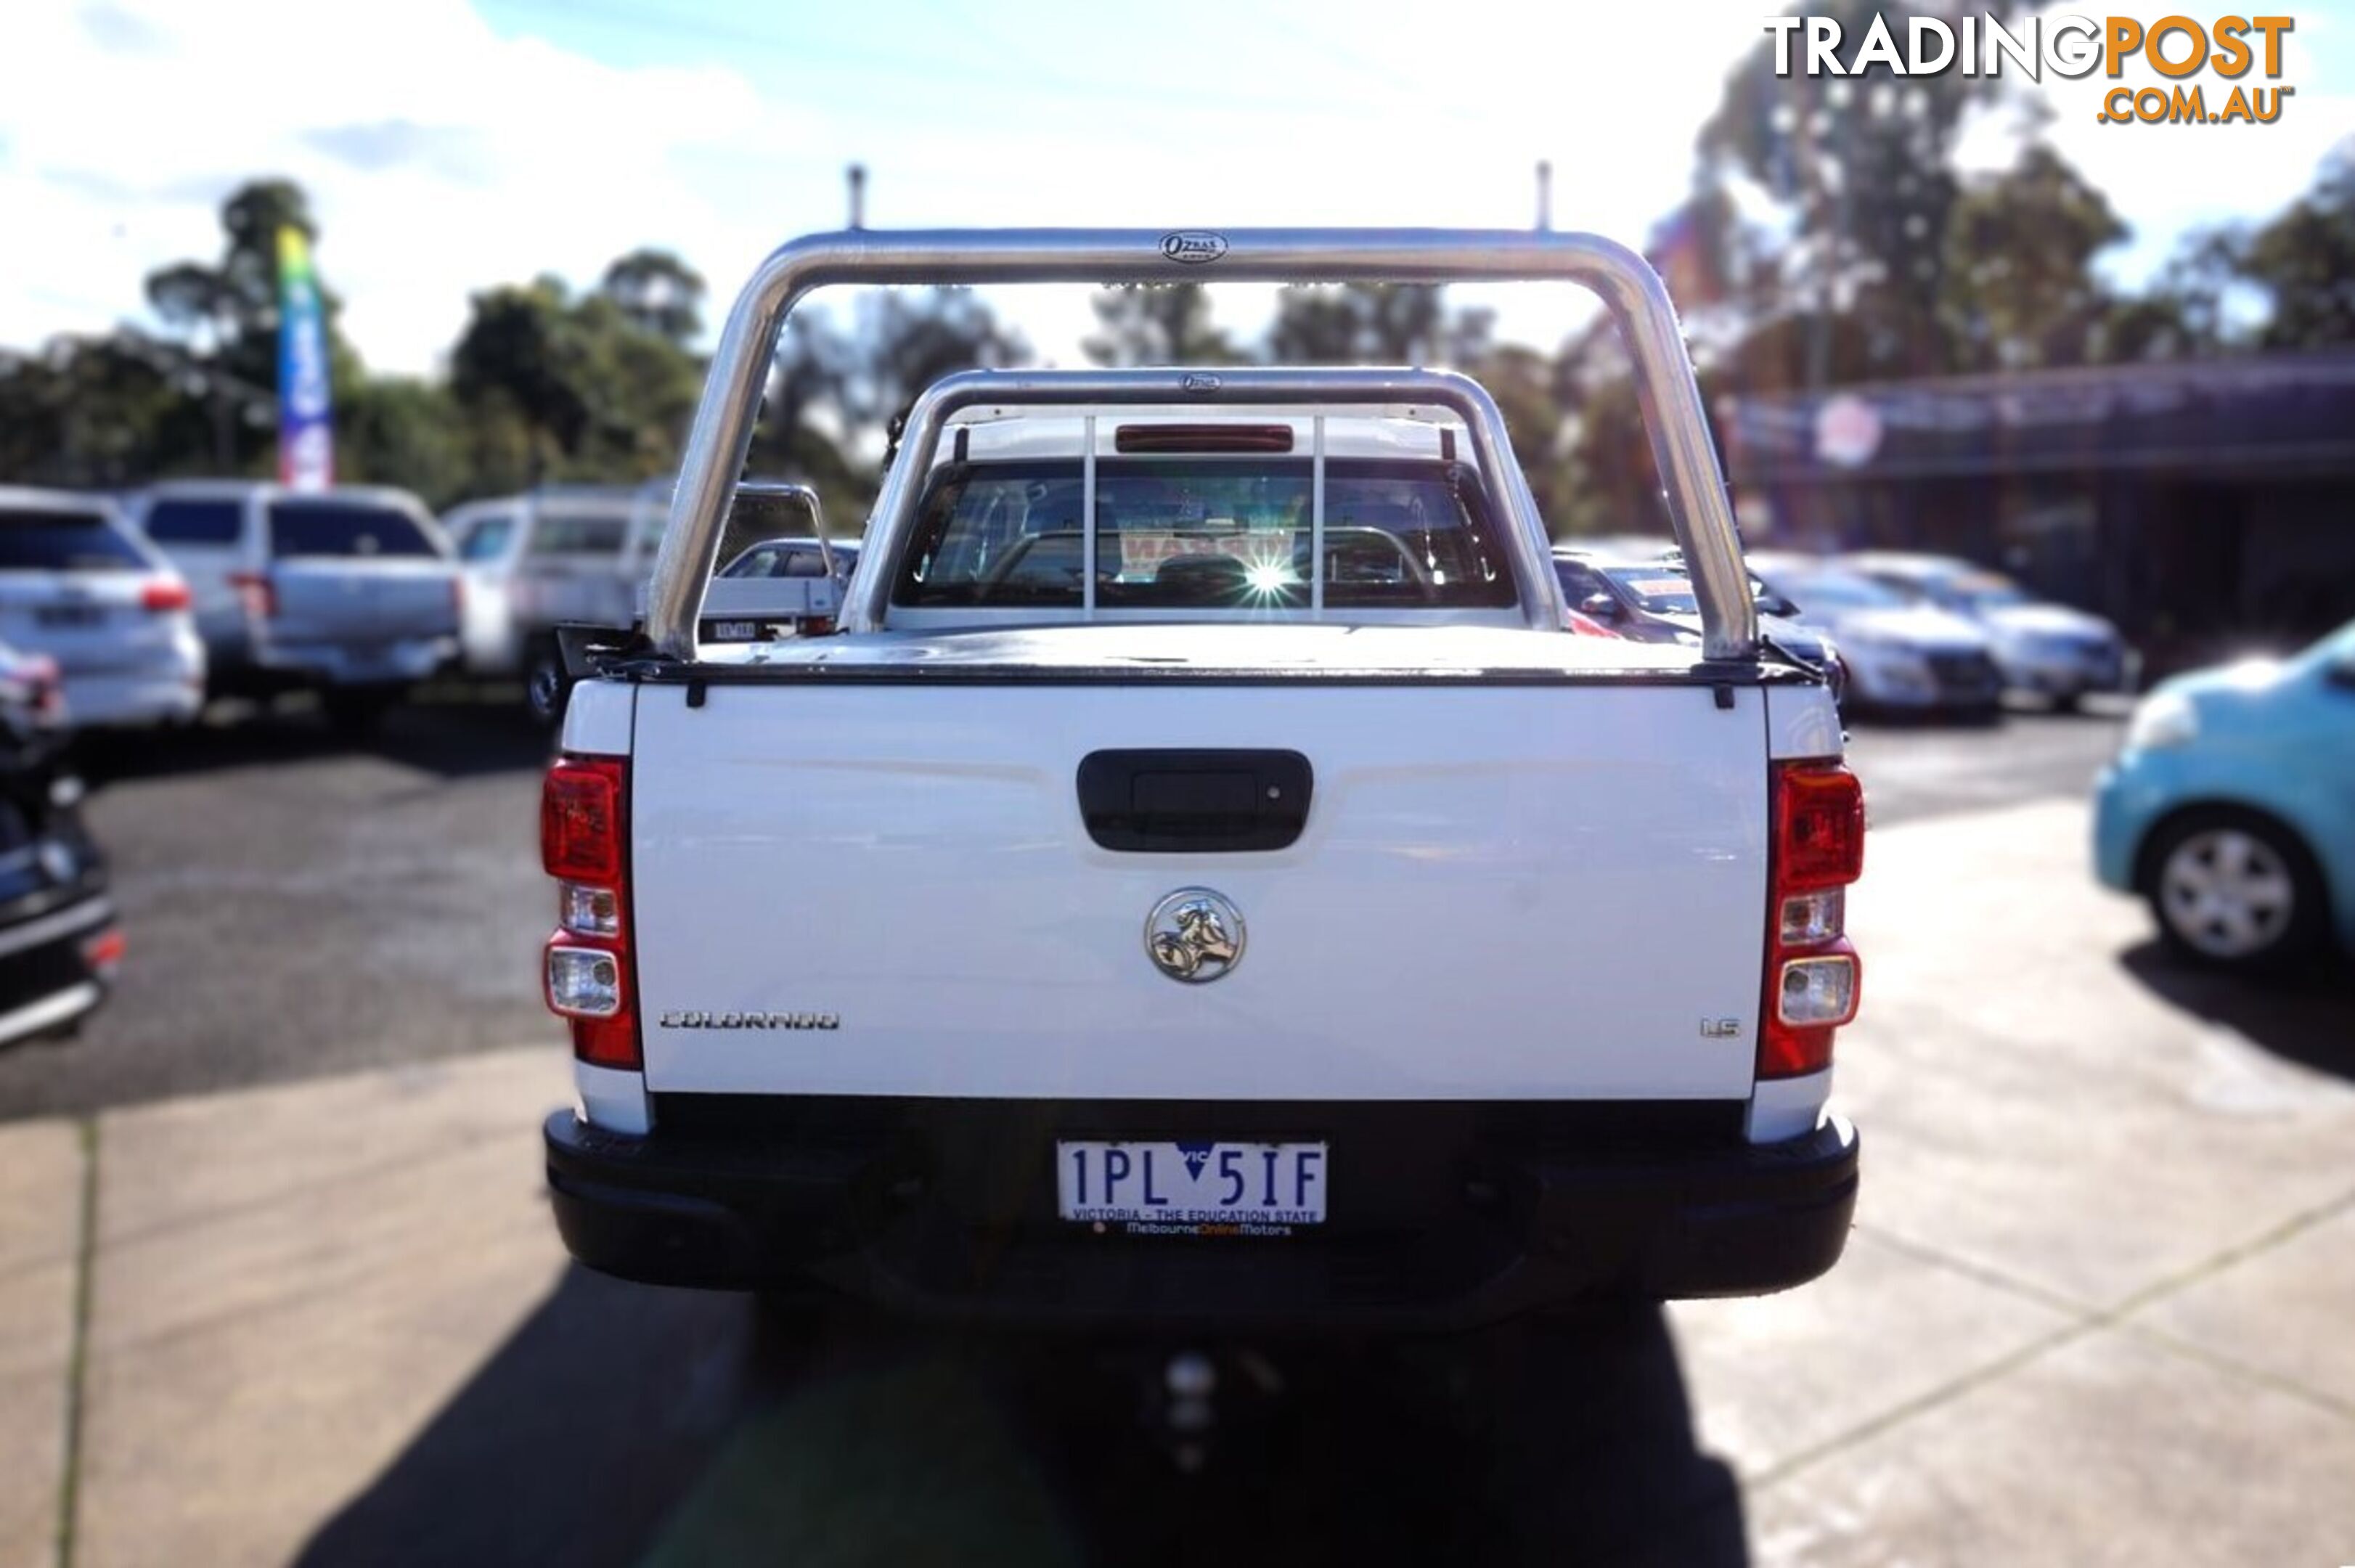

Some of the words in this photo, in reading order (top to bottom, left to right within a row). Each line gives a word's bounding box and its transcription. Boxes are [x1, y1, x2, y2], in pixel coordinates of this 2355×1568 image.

[660, 1011, 840, 1029] COLORADO
[1700, 1018, 1742, 1037] LS
[1182, 1151, 1210, 1161] VIC
[1072, 1149, 1169, 1205] 1PL
[1220, 1151, 1321, 1207] 5IF
[1073, 1209, 1140, 1221] VICTORIA
[1156, 1209, 1184, 1221] THE
[1188, 1209, 1271, 1222] EDUCATION
[1276, 1211, 1318, 1223] STATE
